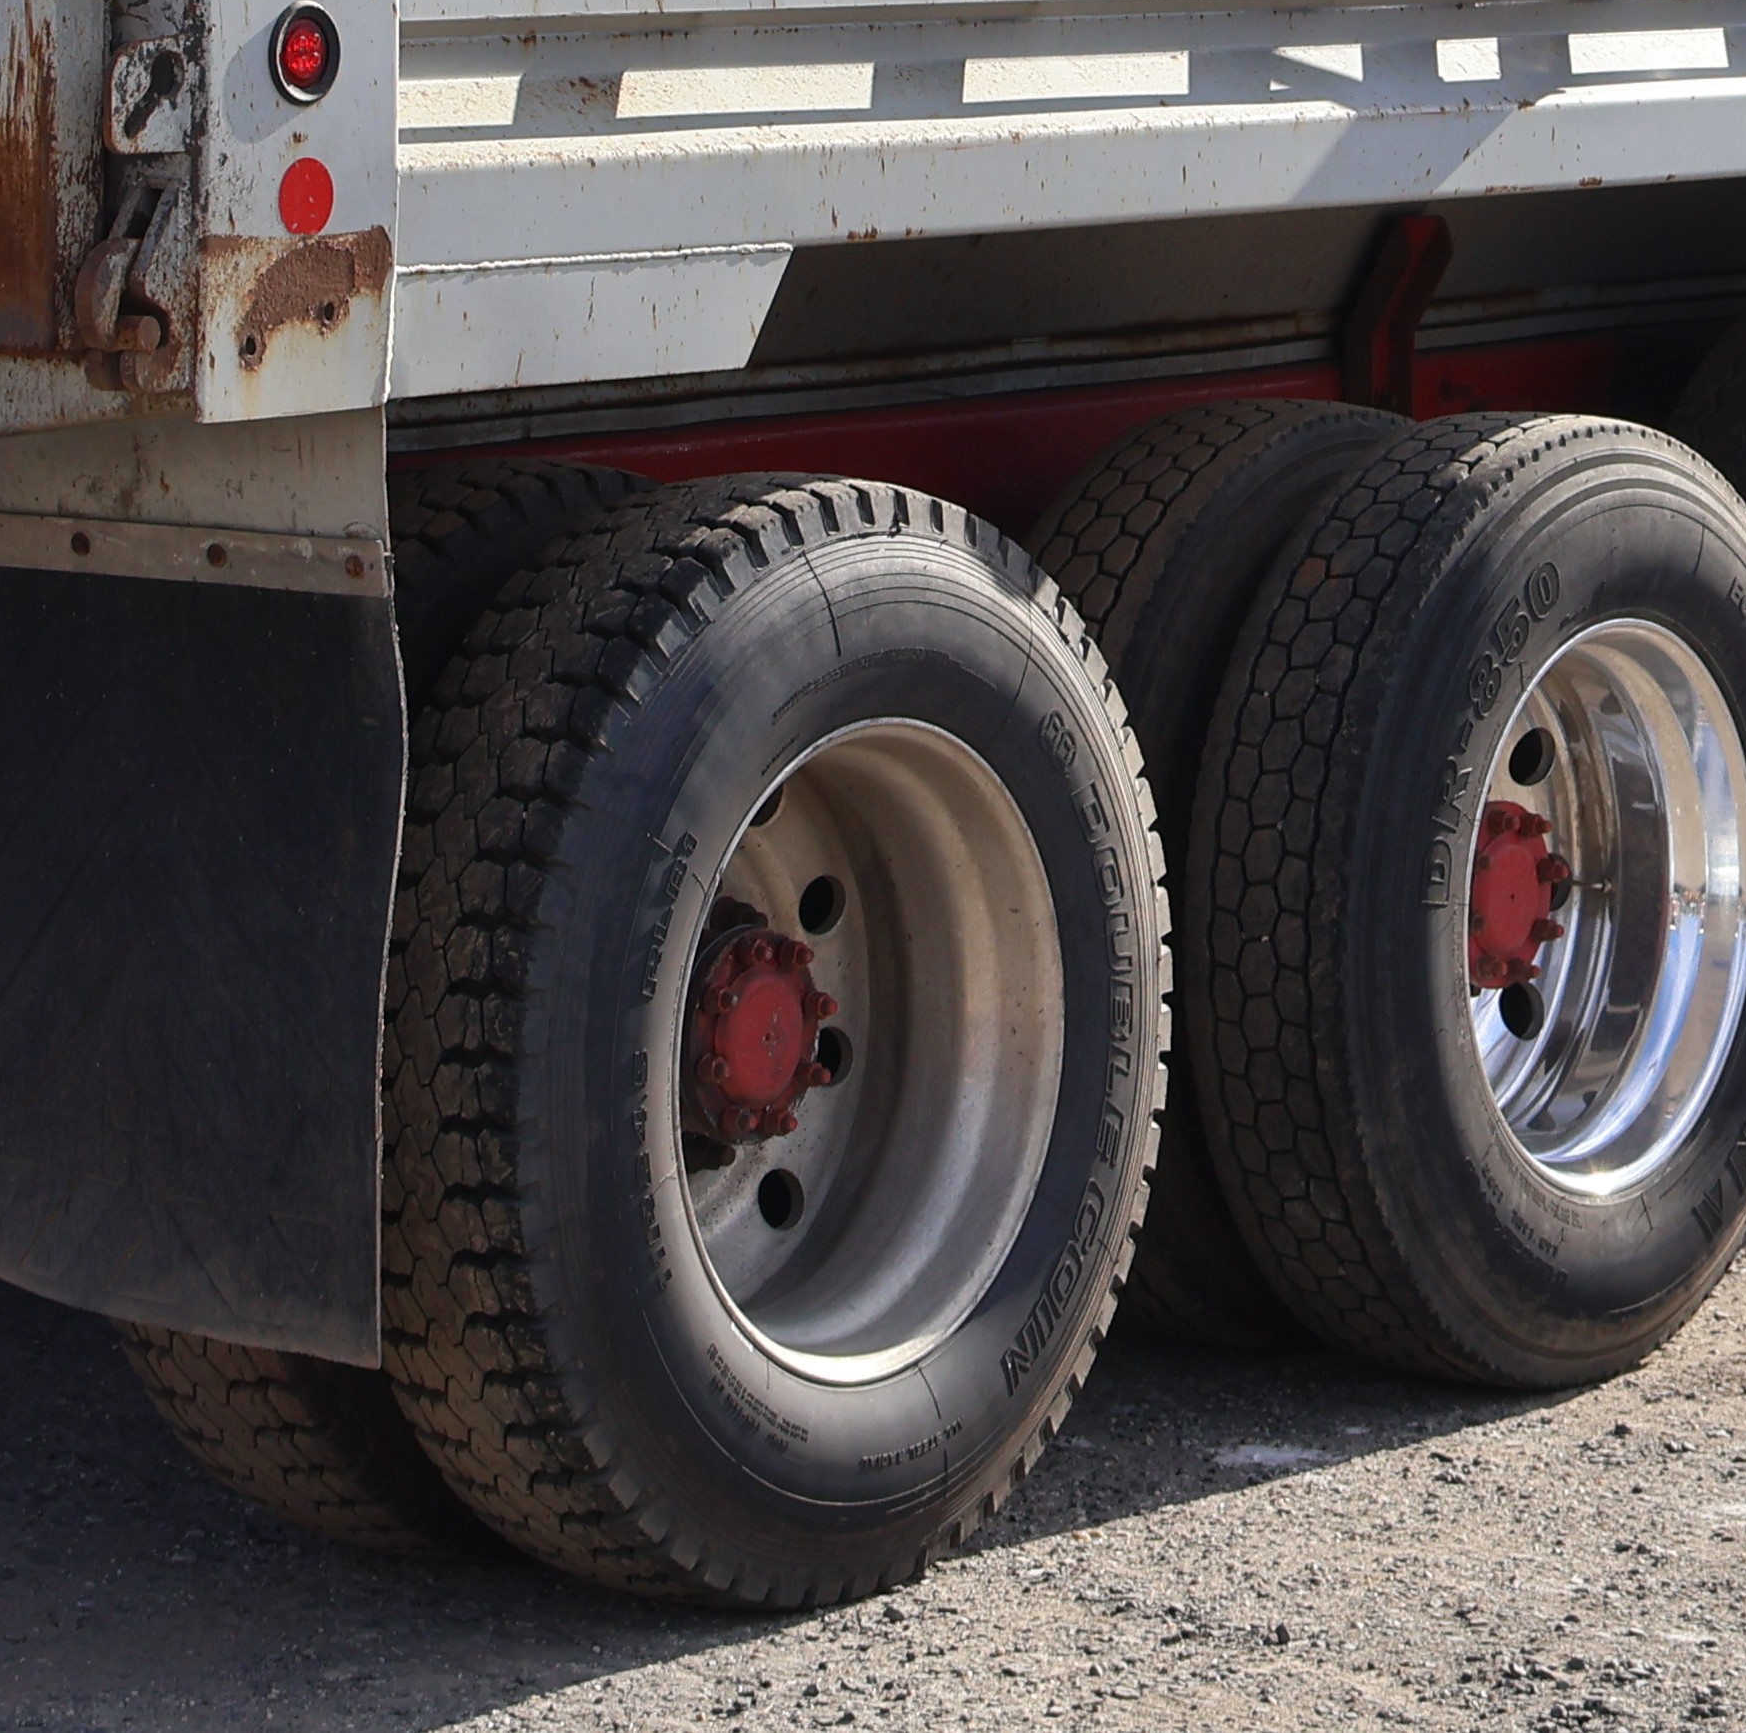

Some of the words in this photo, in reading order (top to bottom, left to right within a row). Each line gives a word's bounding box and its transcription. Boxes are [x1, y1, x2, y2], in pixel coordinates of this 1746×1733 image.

[1418, 559, 1562, 911] DR-850
[1071, 777, 1135, 1172] DOUBLE
[998, 1175, 1107, 1398] COIN
